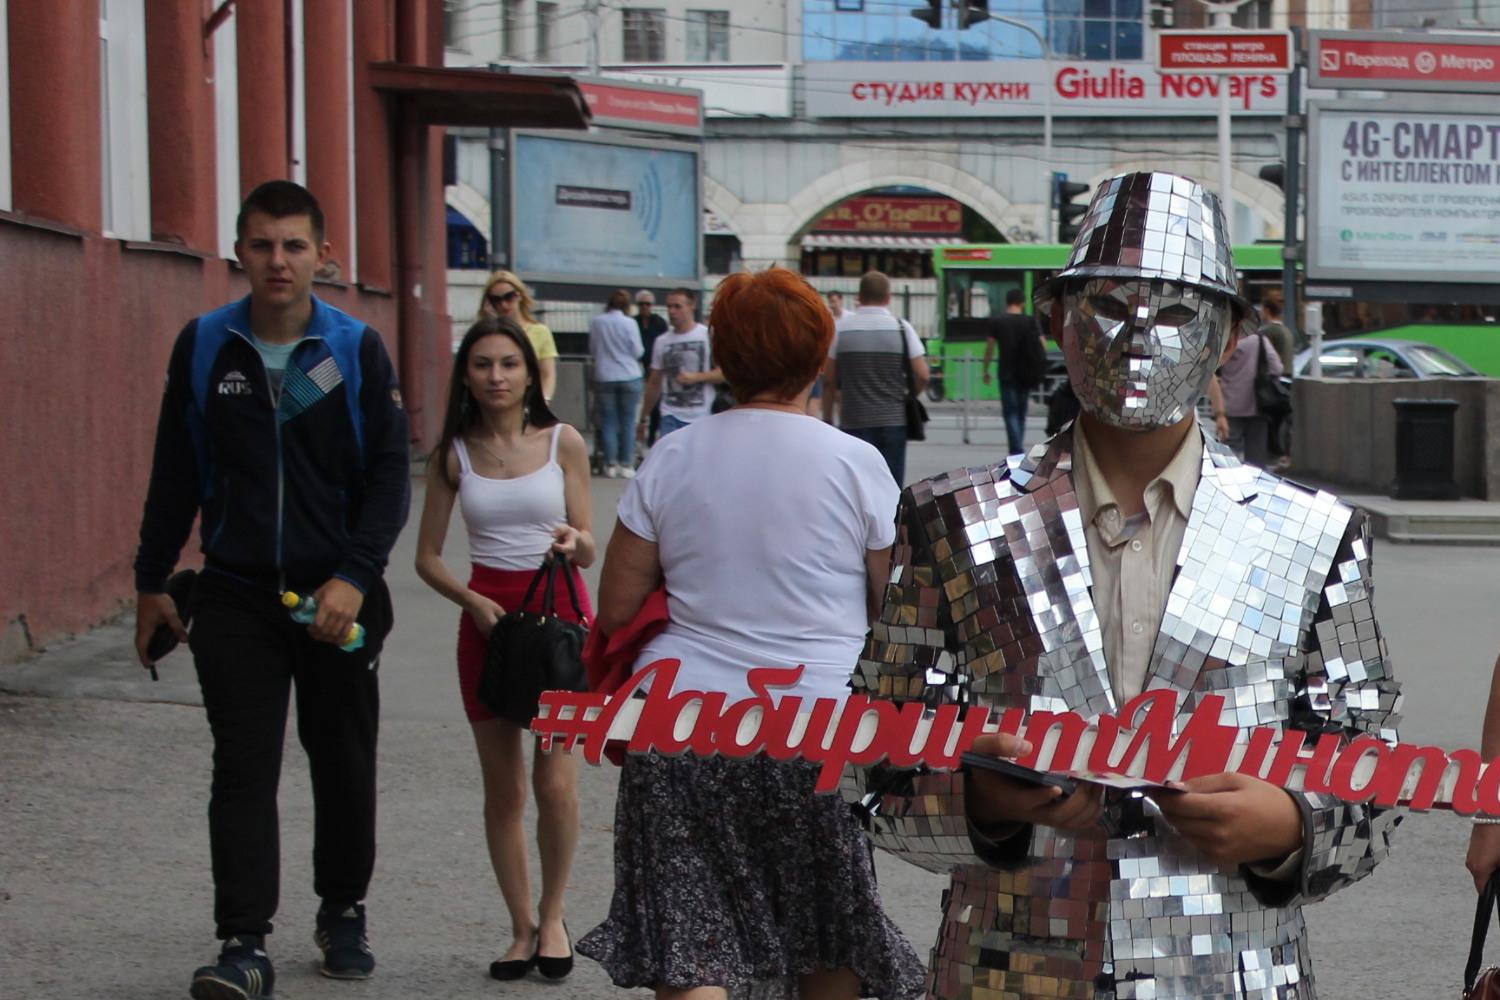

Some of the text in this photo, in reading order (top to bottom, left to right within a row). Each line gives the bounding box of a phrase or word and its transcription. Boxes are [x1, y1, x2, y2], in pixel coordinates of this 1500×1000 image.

[1170, 52, 1278, 63] ПЛОЩАДЬ ЛЕНИНА
[1344, 52, 1409, 69] Переход
[1440, 54, 1494, 72] Метро
[1055, 67, 1278, 110] Giulia Novars
[1341, 161, 1352, 182] С
[1356, 162, 1492, 185] ИНТЕЛЛЕКТОМ
[218, 381, 252, 395] RUS
